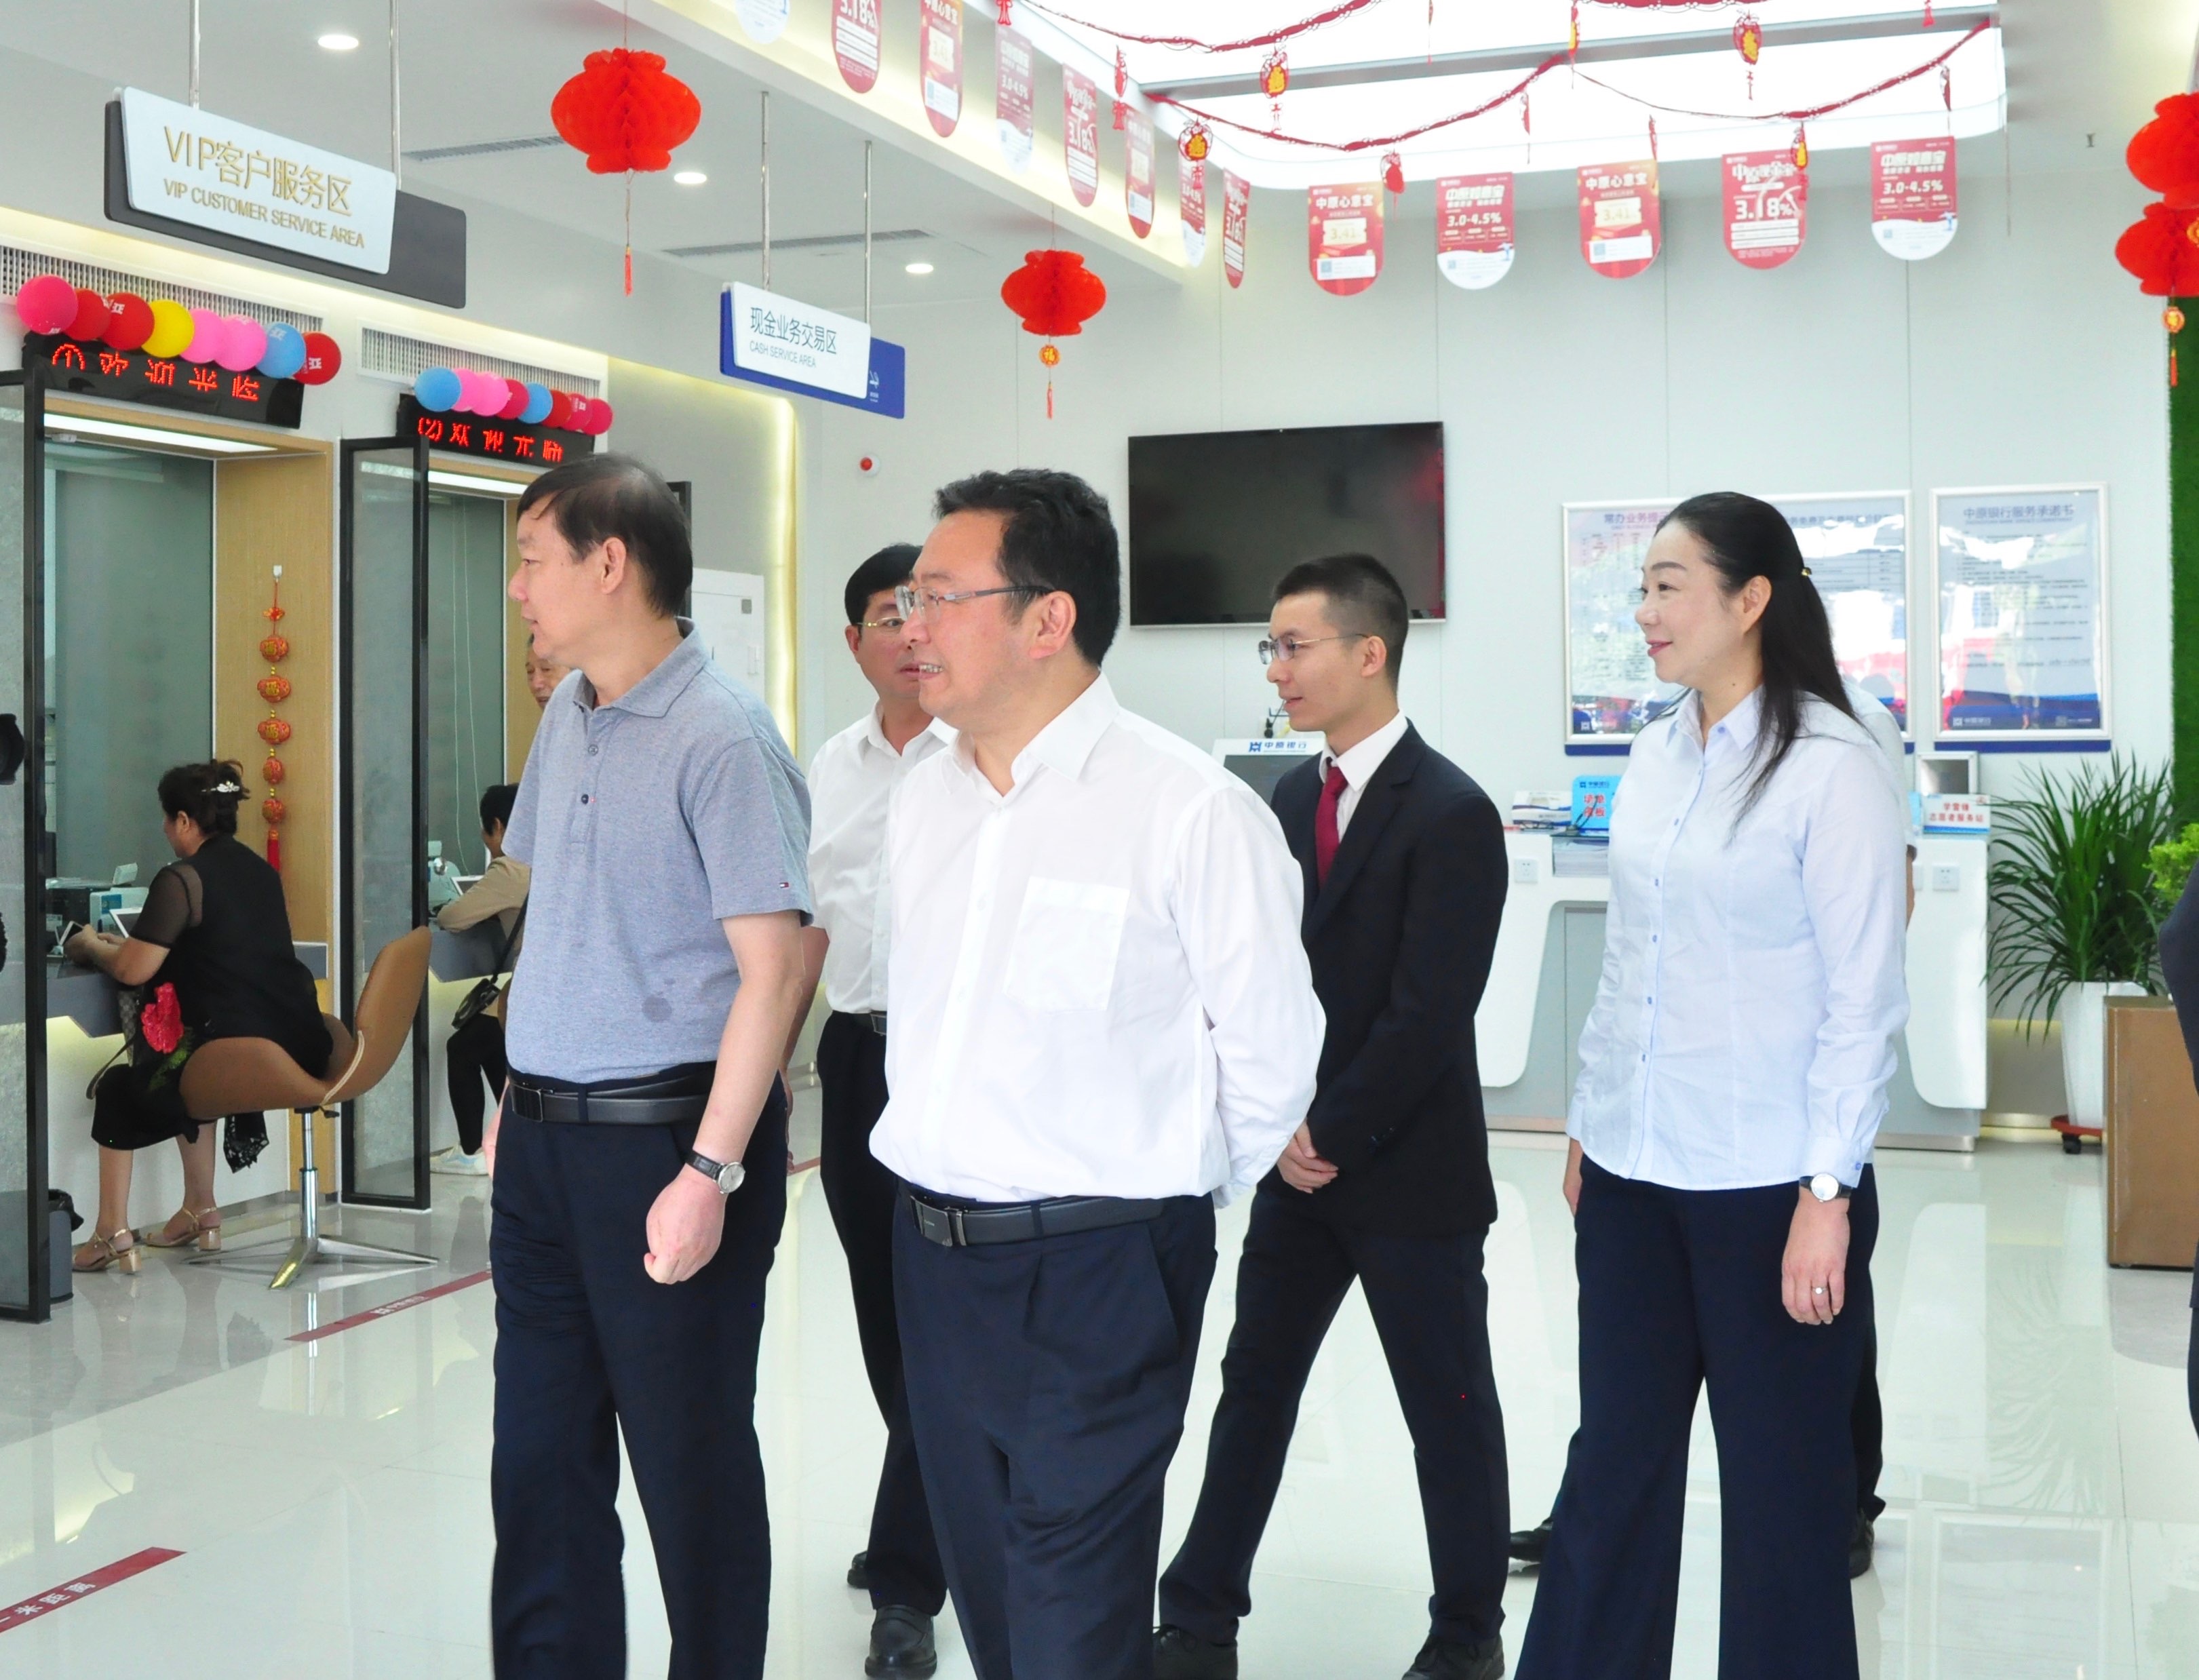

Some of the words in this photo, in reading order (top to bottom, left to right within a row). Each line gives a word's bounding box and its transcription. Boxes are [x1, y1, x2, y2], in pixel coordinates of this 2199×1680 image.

[163, 125, 353, 216] VIP客户服务区
[163, 178, 188, 199] VIP
[191, 187, 269, 222] CUSTOMER
[271, 210, 328, 239] SERVICE
[330, 224, 366, 249] AREA
[750, 307, 838, 355] 现金业务交易区
[750, 340, 769, 356] CASH
[770, 345, 798, 364] SERVICE
[799, 353, 817, 368] AREA
[1264, 741, 1307, 749] 中原银行
